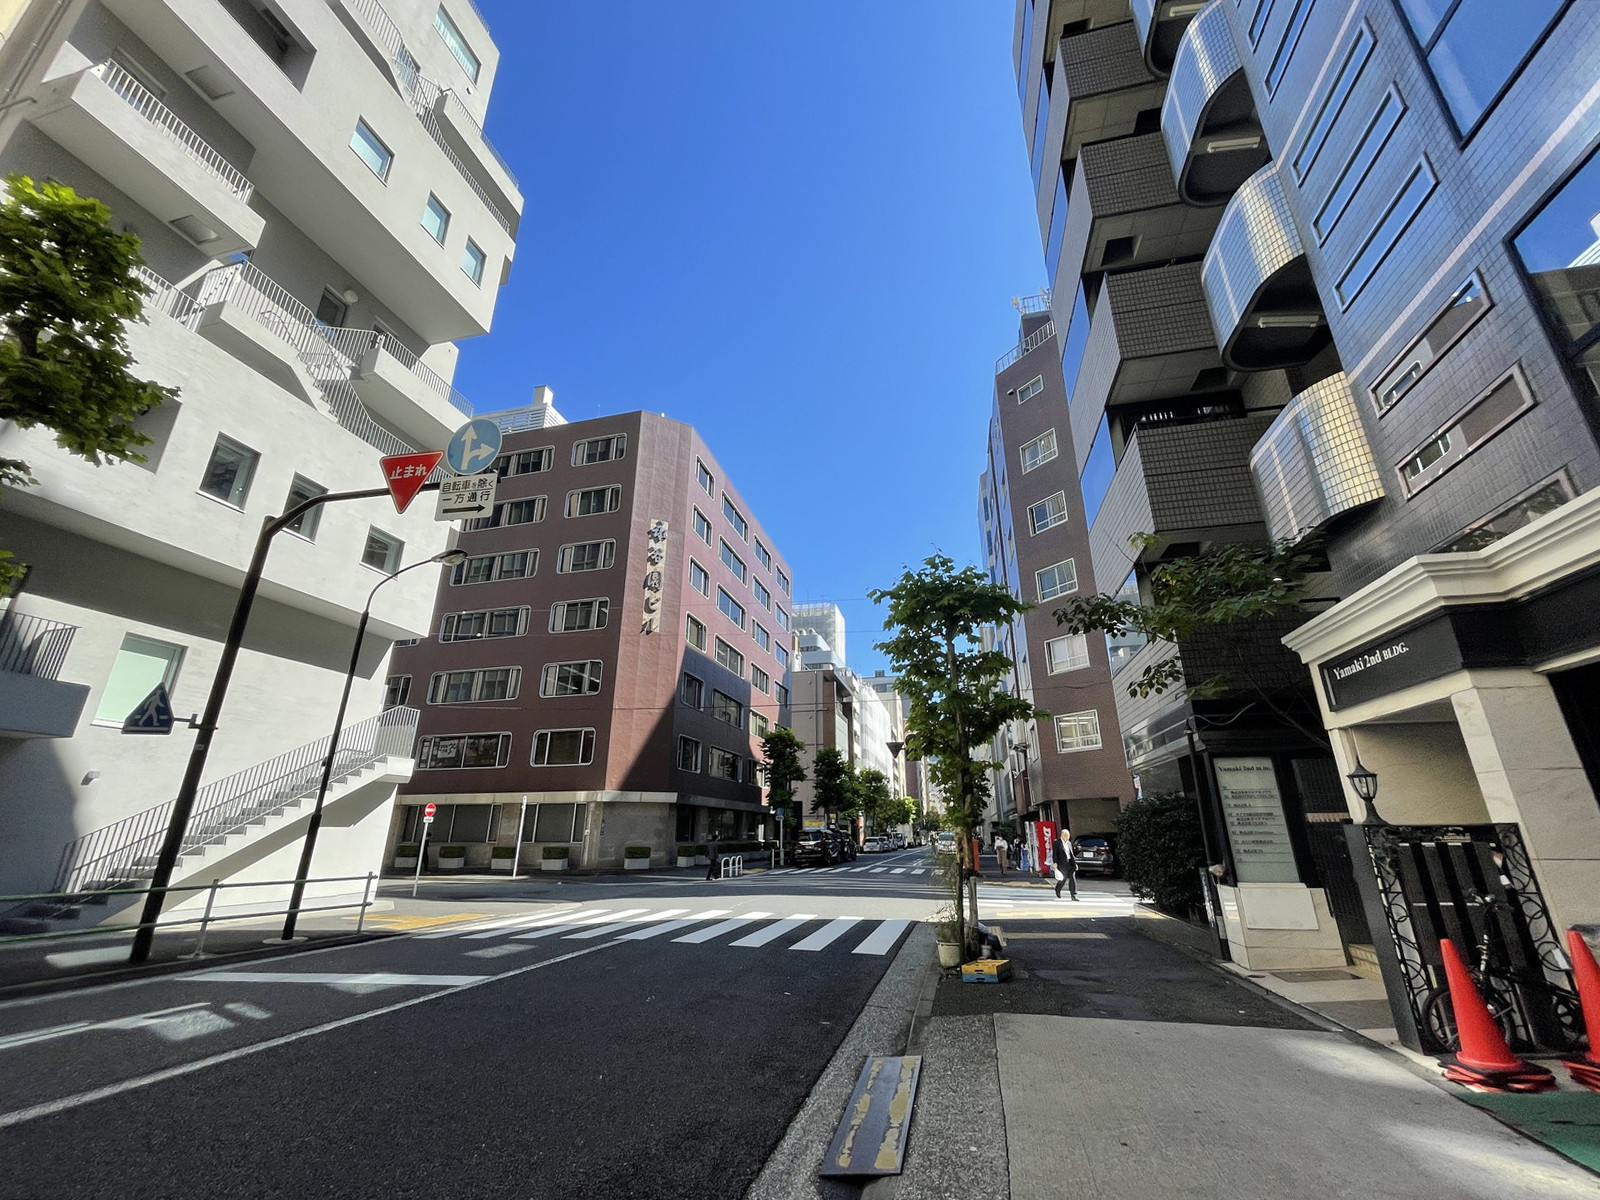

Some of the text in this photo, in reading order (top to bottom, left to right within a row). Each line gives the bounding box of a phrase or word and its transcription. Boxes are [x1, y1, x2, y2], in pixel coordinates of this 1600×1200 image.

[389, 464, 428, 480] 止まれ
[442, 478, 494, 492] 自転車を除く
[442, 491, 491, 504] 一方通行
[1333, 641, 1409, 680] Yamaki 2nd BLDG.
